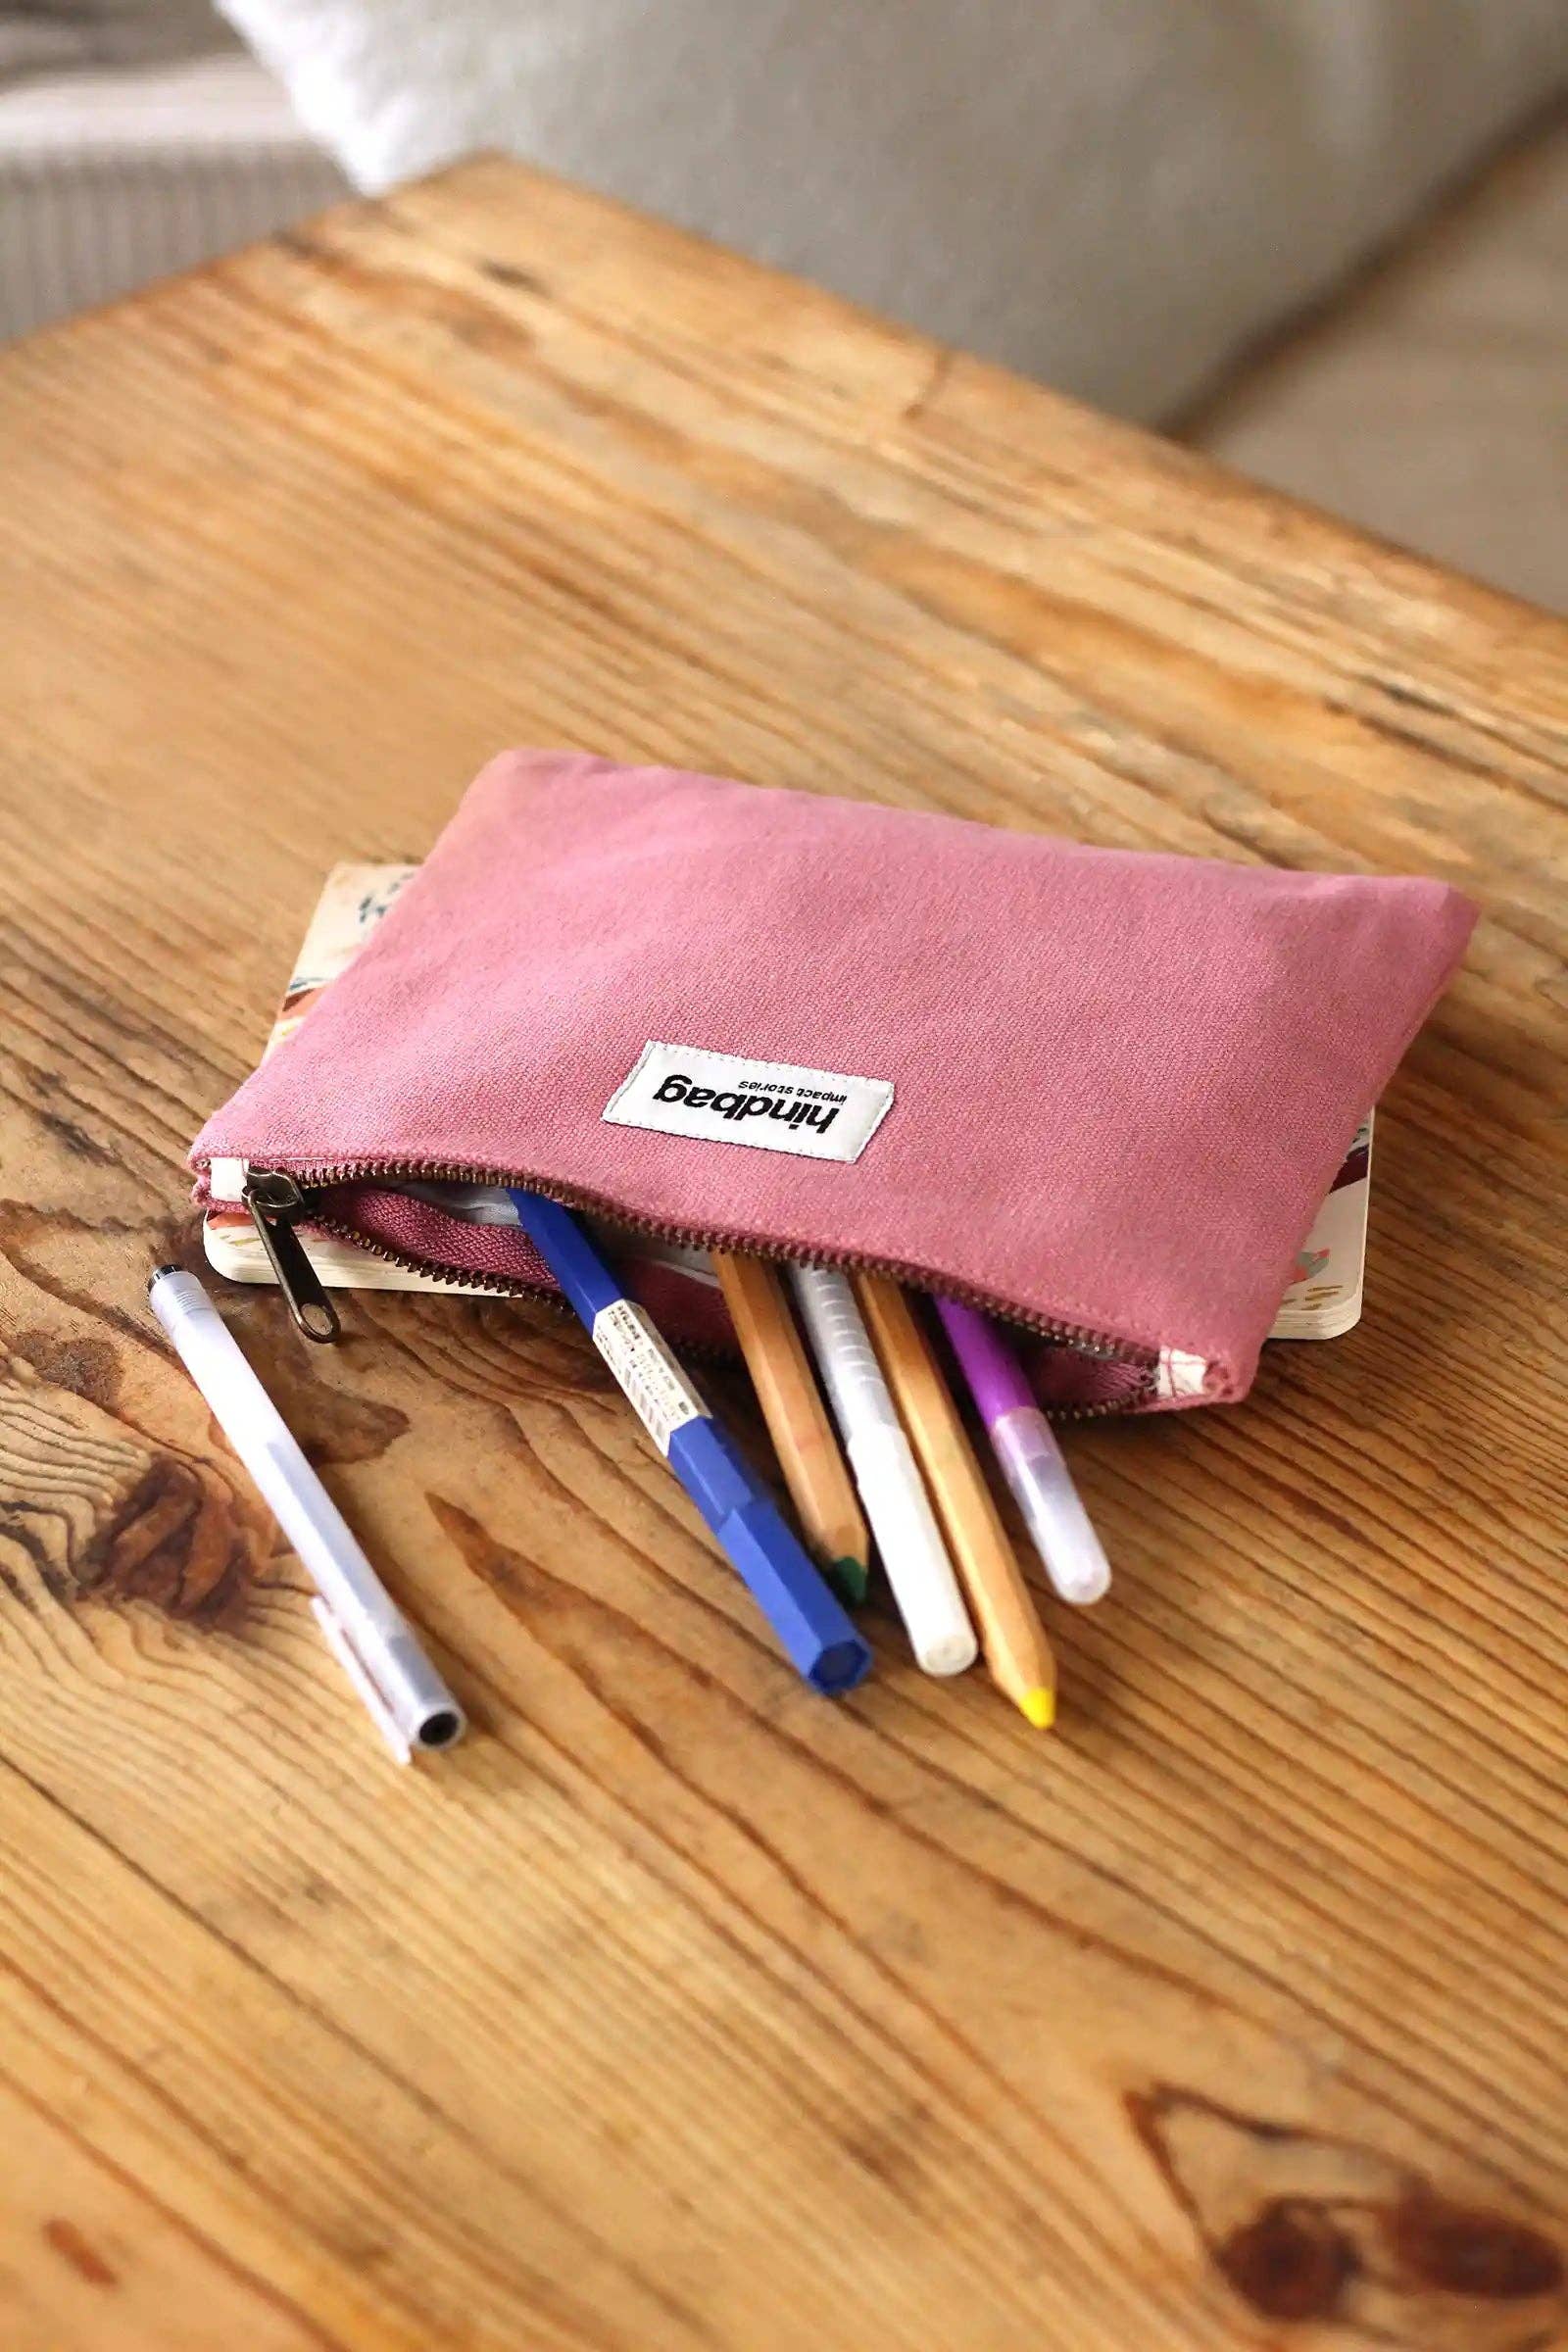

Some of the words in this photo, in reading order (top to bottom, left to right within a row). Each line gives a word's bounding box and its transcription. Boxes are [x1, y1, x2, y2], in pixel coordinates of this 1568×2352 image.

[738, 1081, 795, 1095] stories
[797, 1088, 848, 1105] impact
[653, 1074, 840, 1134] hindbag
